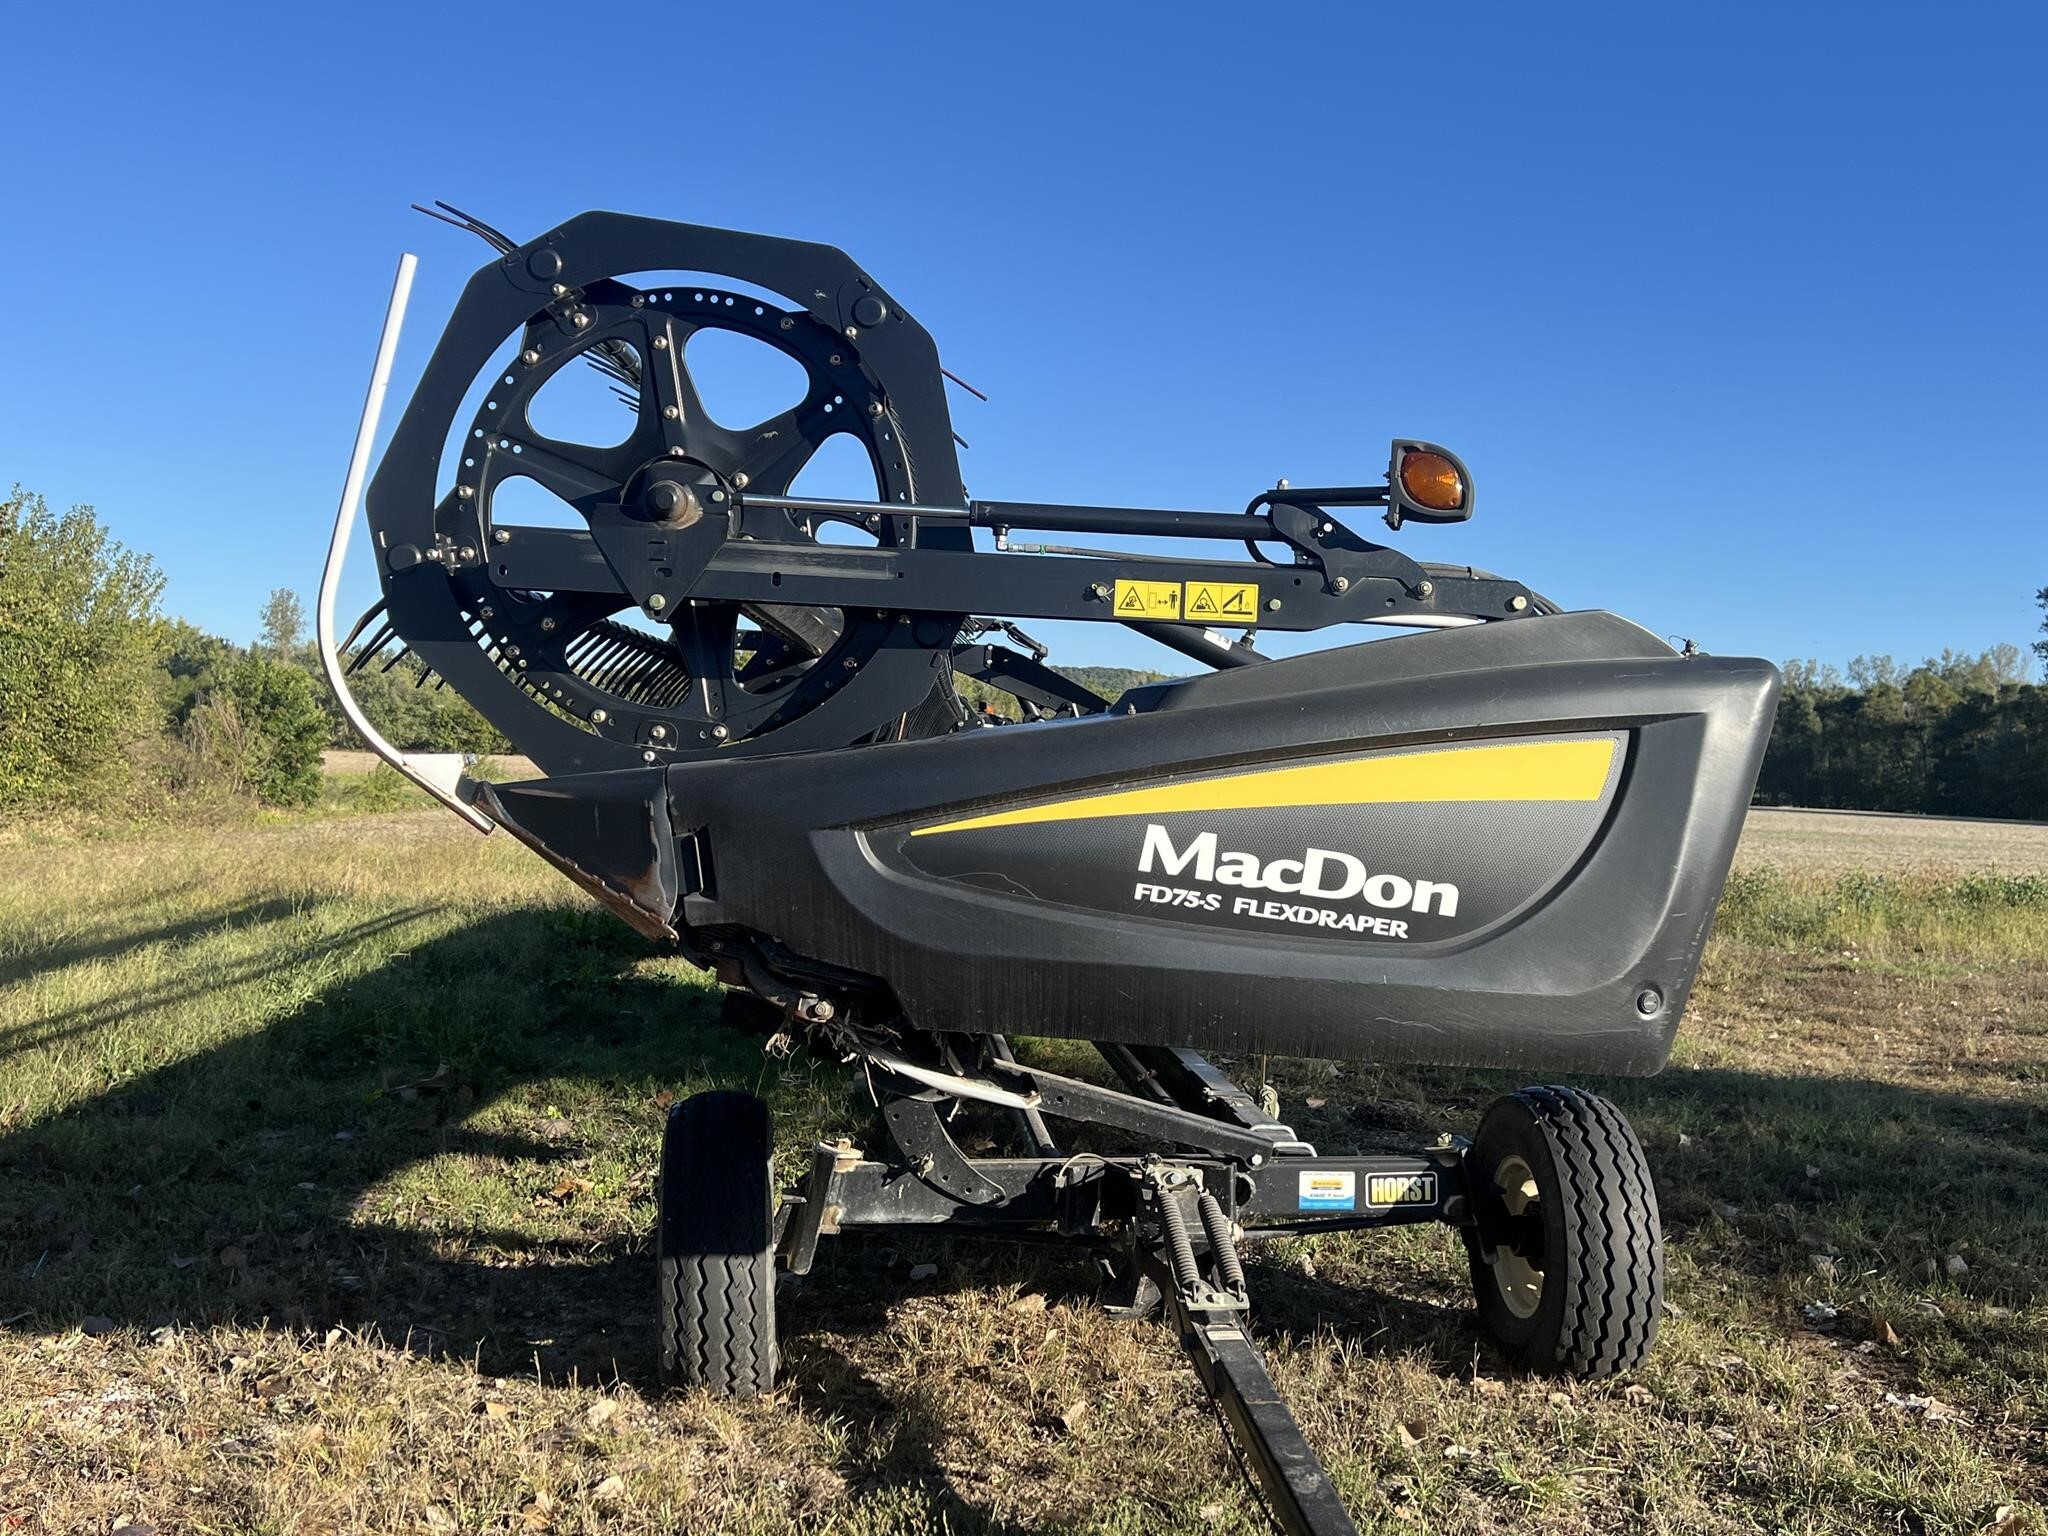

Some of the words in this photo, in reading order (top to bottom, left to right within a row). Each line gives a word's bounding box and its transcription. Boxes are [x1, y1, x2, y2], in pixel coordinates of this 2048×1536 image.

[1138, 824, 1459, 916] MacDon
[1135, 883, 1222, 911] FD75-S
[1233, 898, 1409, 939] FLEXDRAPER
[1372, 1177, 1434, 1203] HORST
